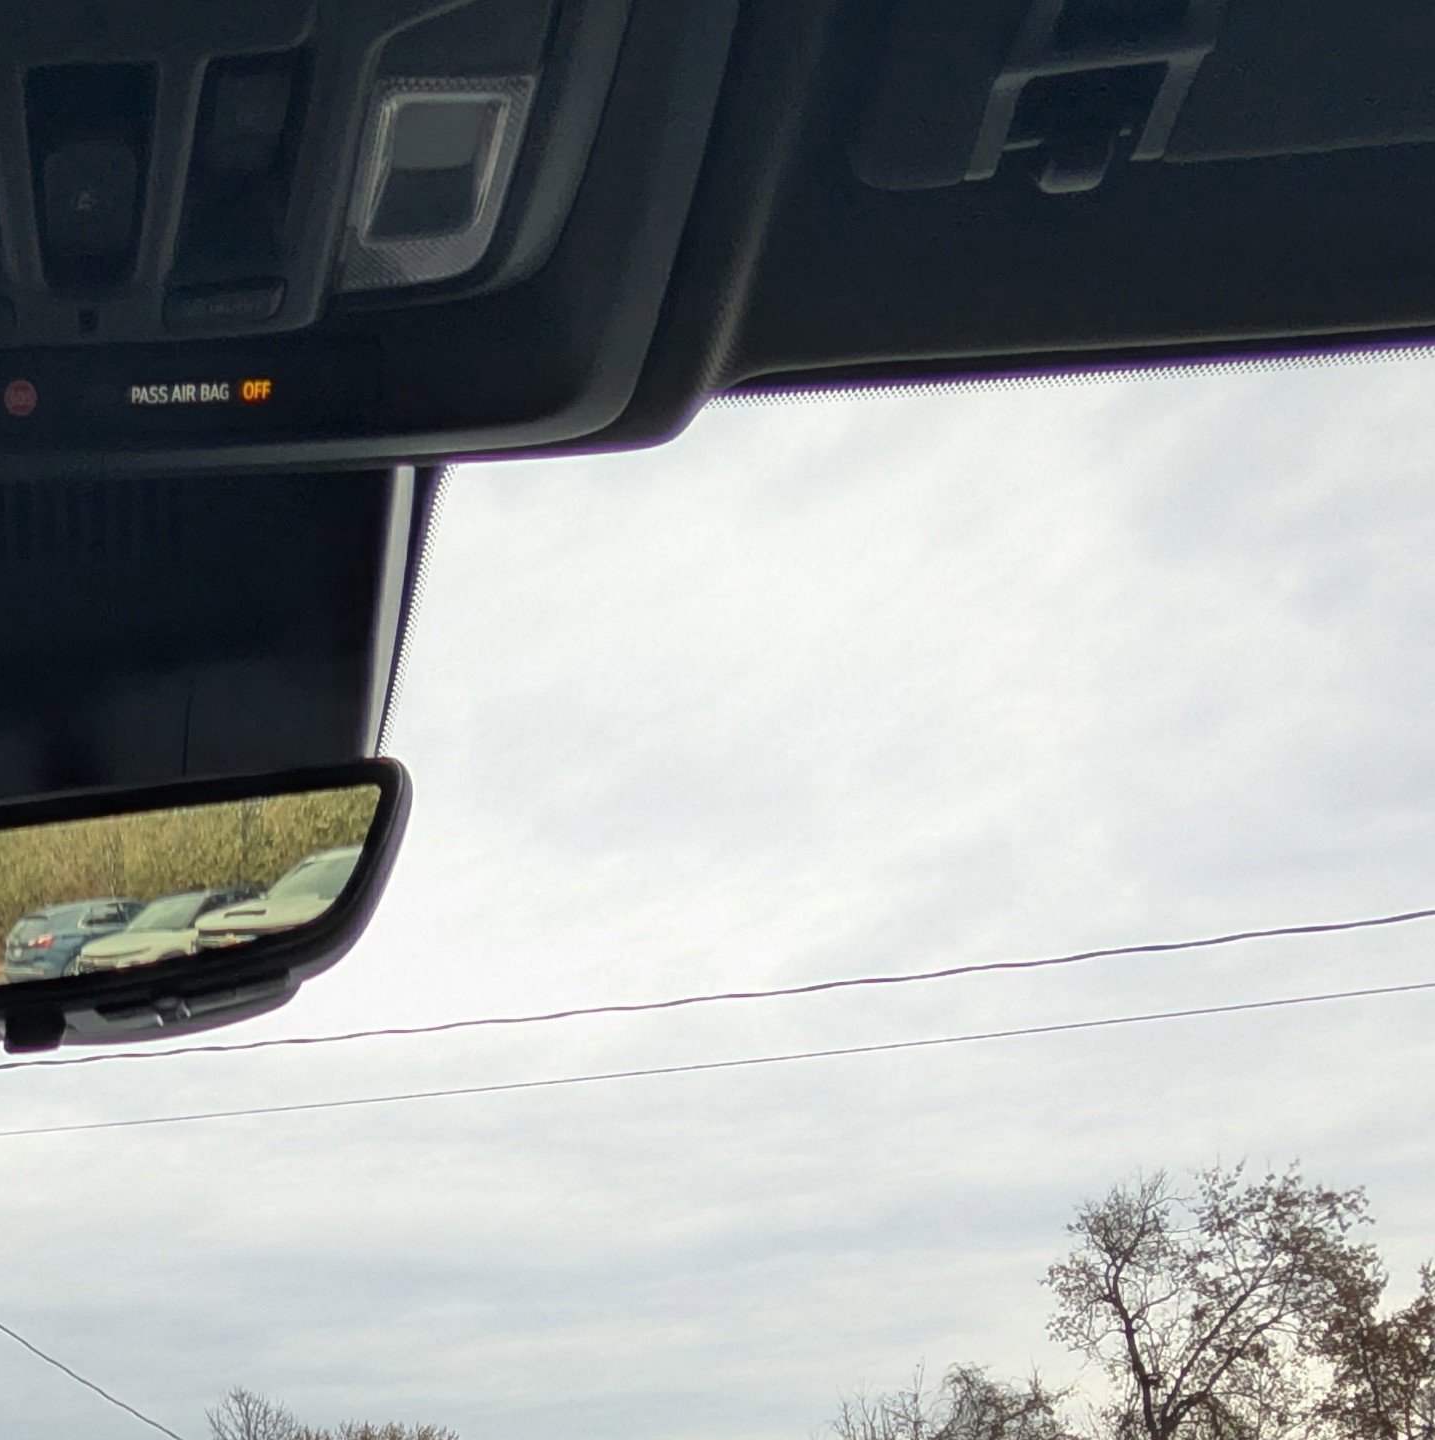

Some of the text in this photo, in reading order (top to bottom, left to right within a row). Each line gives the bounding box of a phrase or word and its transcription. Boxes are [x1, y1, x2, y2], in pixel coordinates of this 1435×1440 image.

[132, 380, 271, 404] PASS AIR BAG OFF
